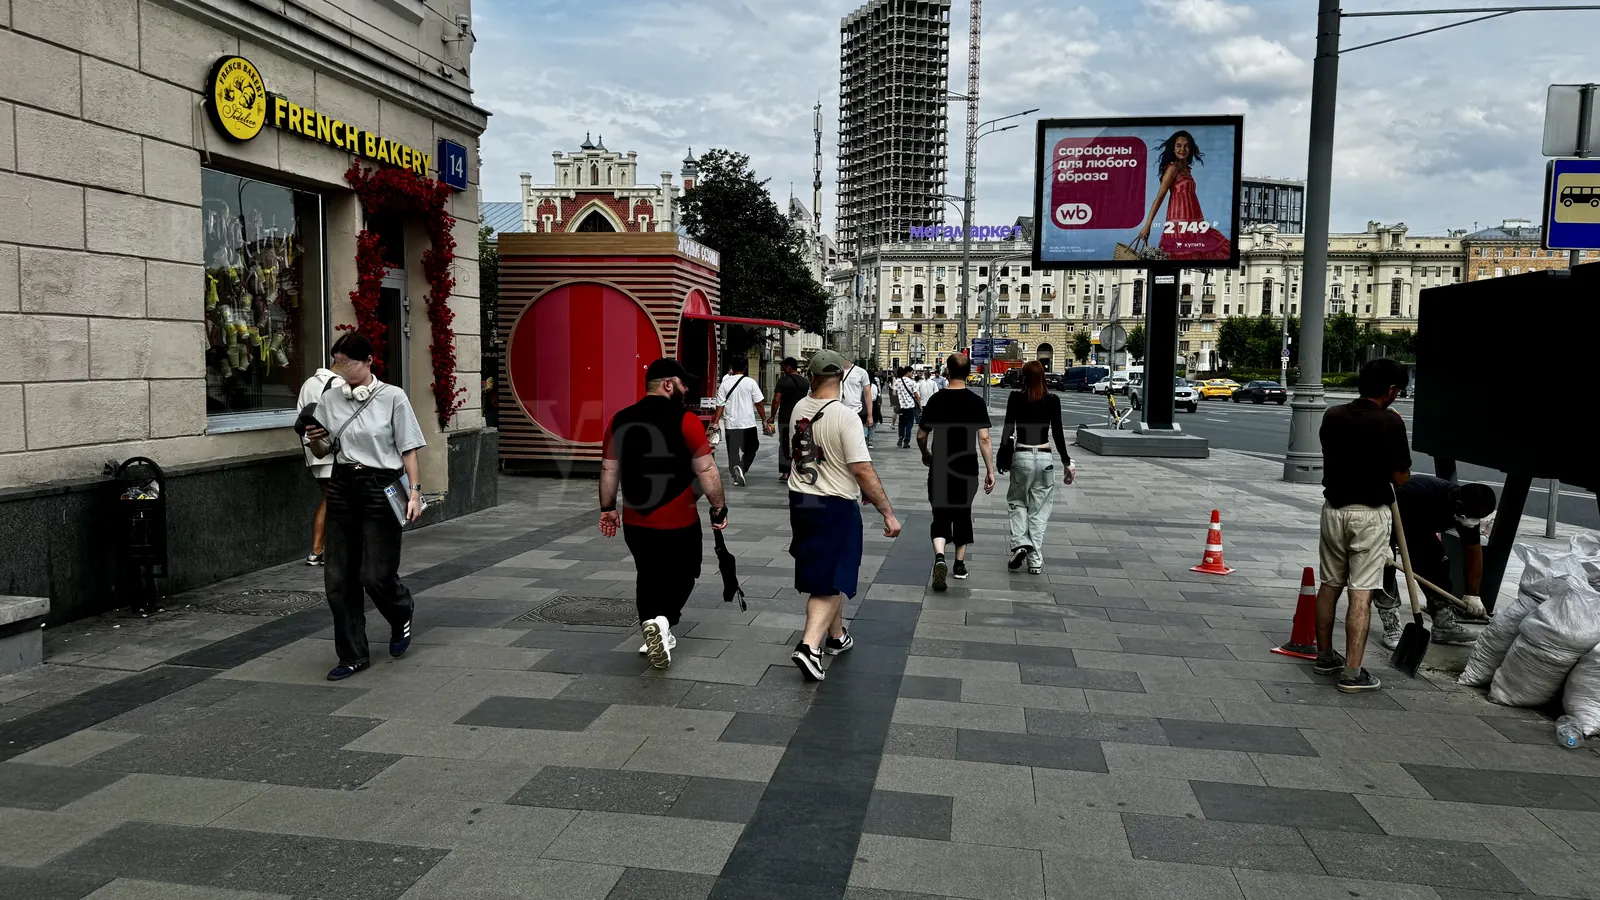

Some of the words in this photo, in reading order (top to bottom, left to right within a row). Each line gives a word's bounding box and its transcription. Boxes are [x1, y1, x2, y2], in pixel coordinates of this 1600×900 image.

[219, 62, 242, 85] FRENCH
[243, 64, 264, 99] BAKERY
[275, 97, 360, 153] FRENCH
[364, 131, 432, 177] BAKERY
[1058, 145, 1132, 157] сарафаны
[450, 154, 464, 178] 14
[1057, 159, 1083, 169] для
[1085, 156, 1138, 168] любого
[1057, 170, 1109, 183] образа
[1060, 205, 1088, 220] wb
